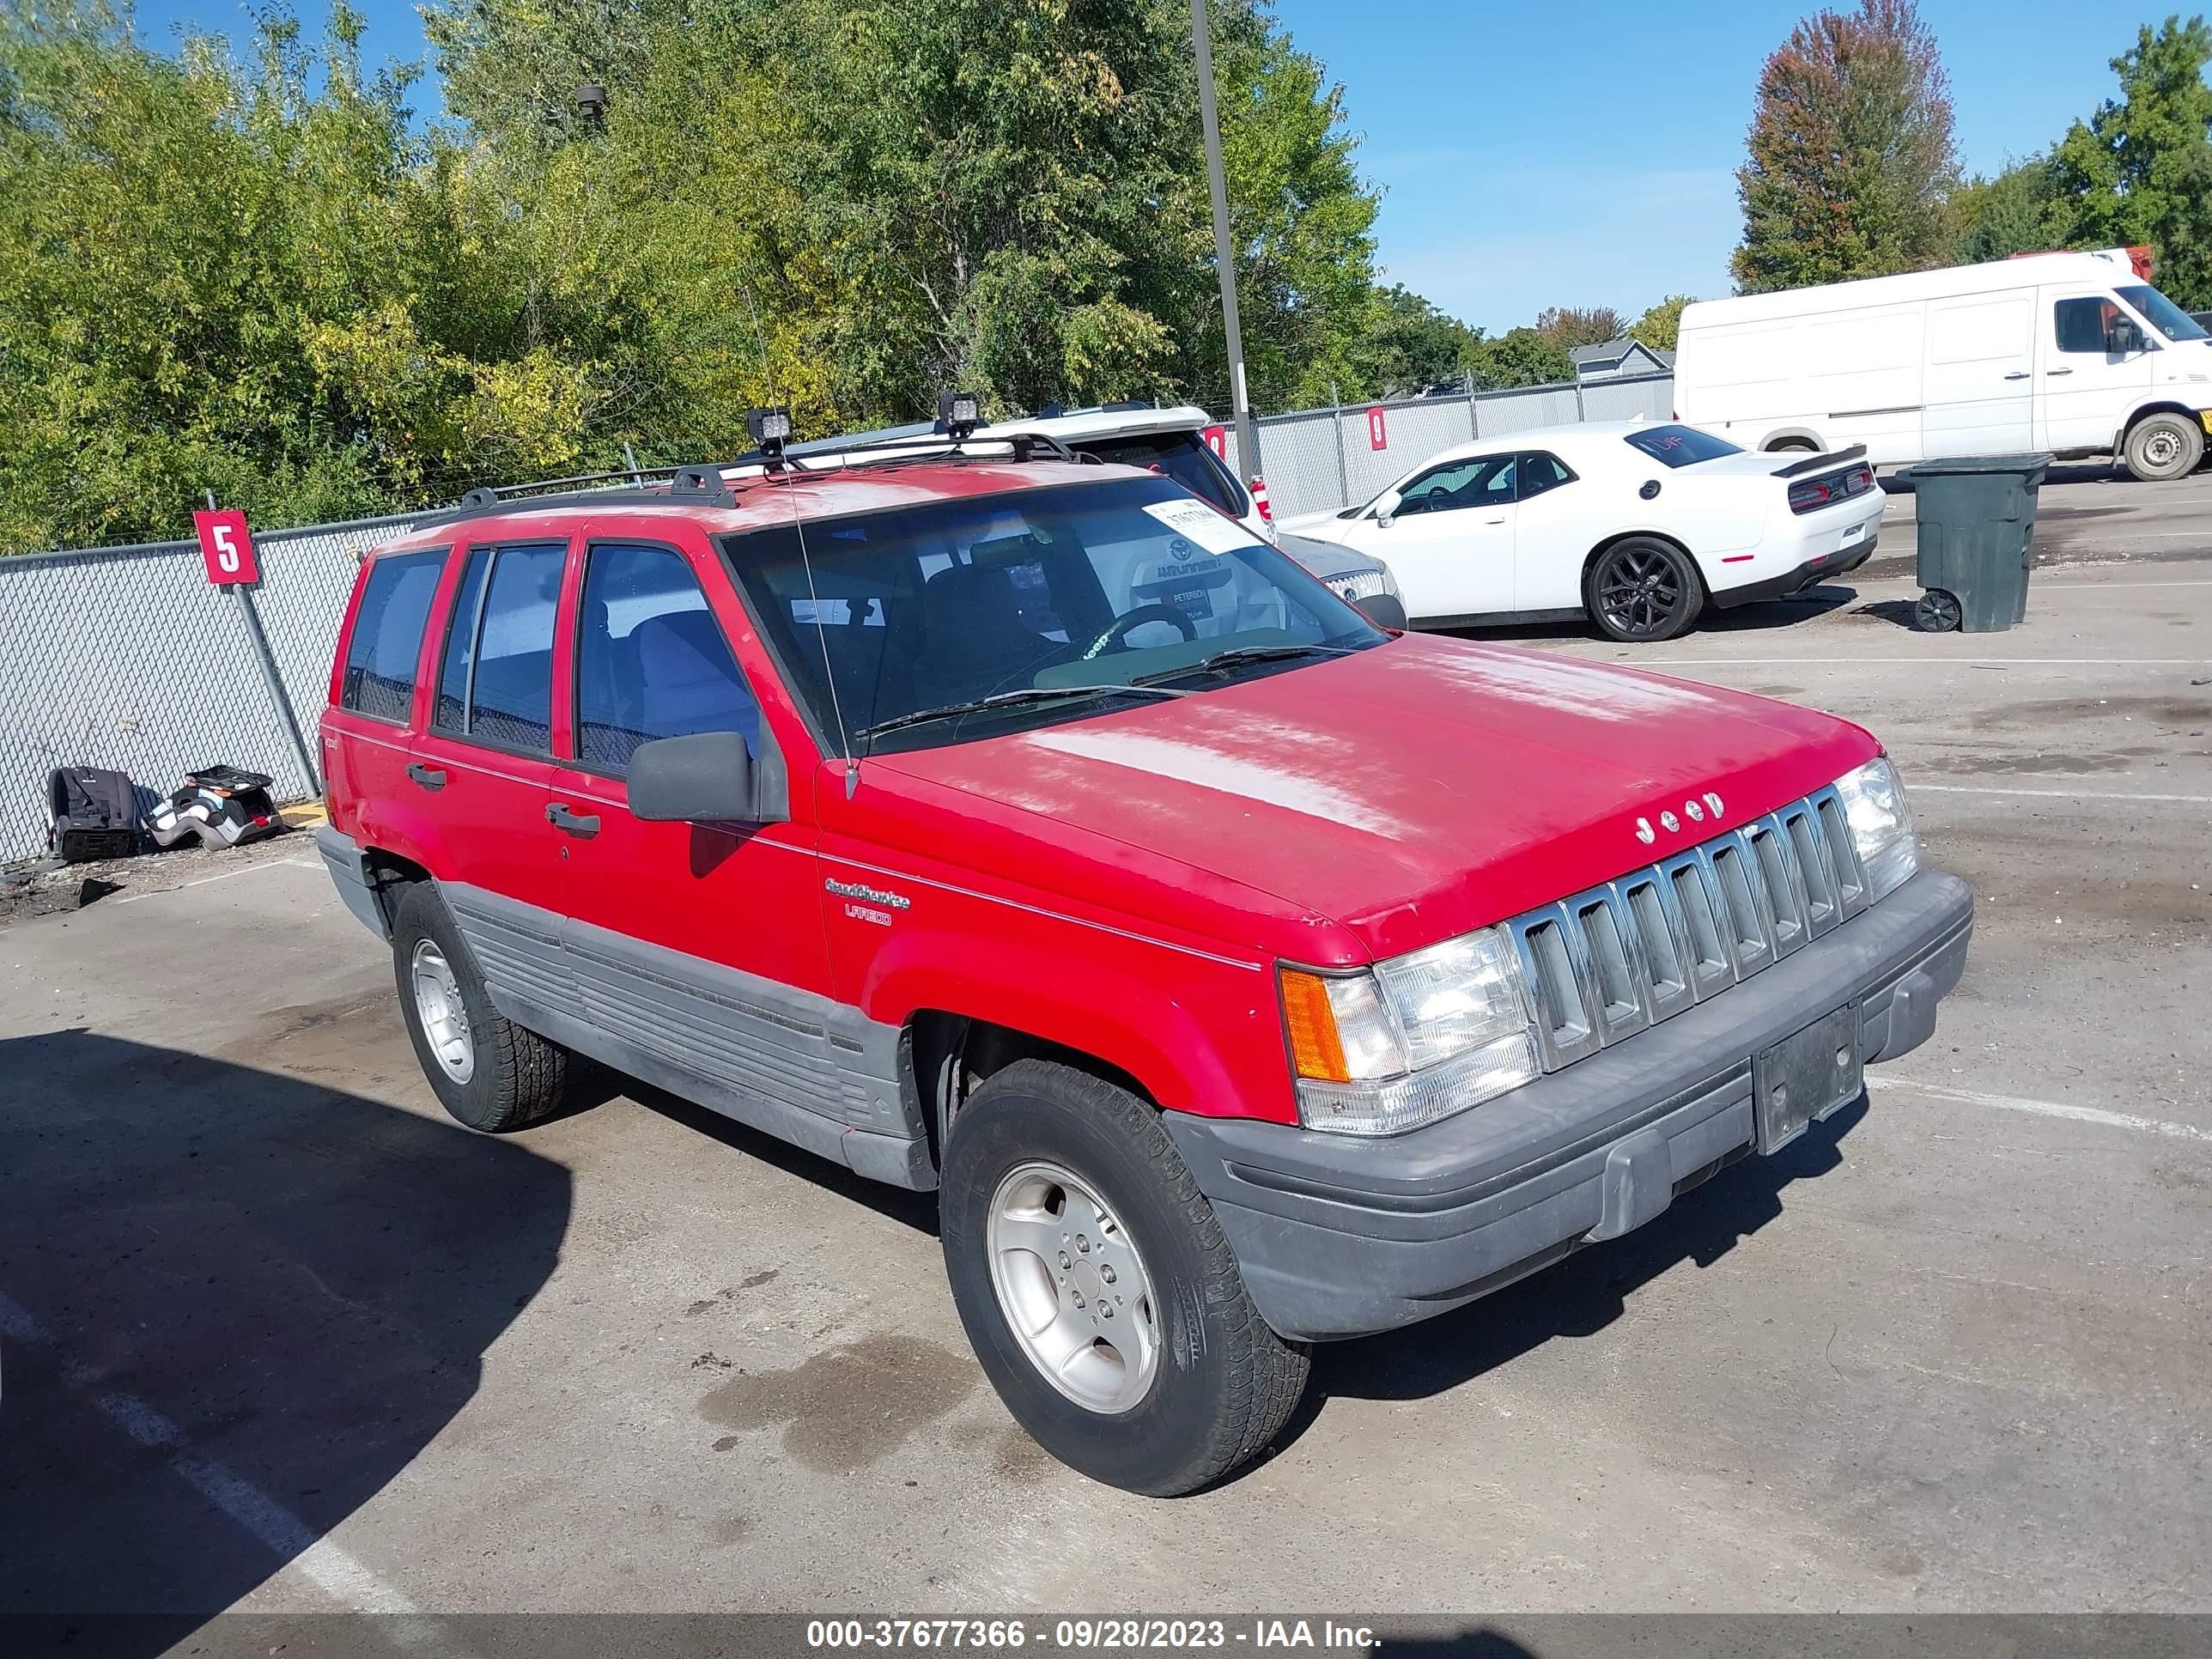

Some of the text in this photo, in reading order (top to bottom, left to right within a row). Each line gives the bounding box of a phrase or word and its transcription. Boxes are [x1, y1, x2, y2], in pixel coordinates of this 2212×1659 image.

[1373, 415, 1382, 442] 9
[212, 526, 240, 573] 5
[1635, 792, 1724, 844] Jeep
[845, 903, 891, 926] LAREDO
